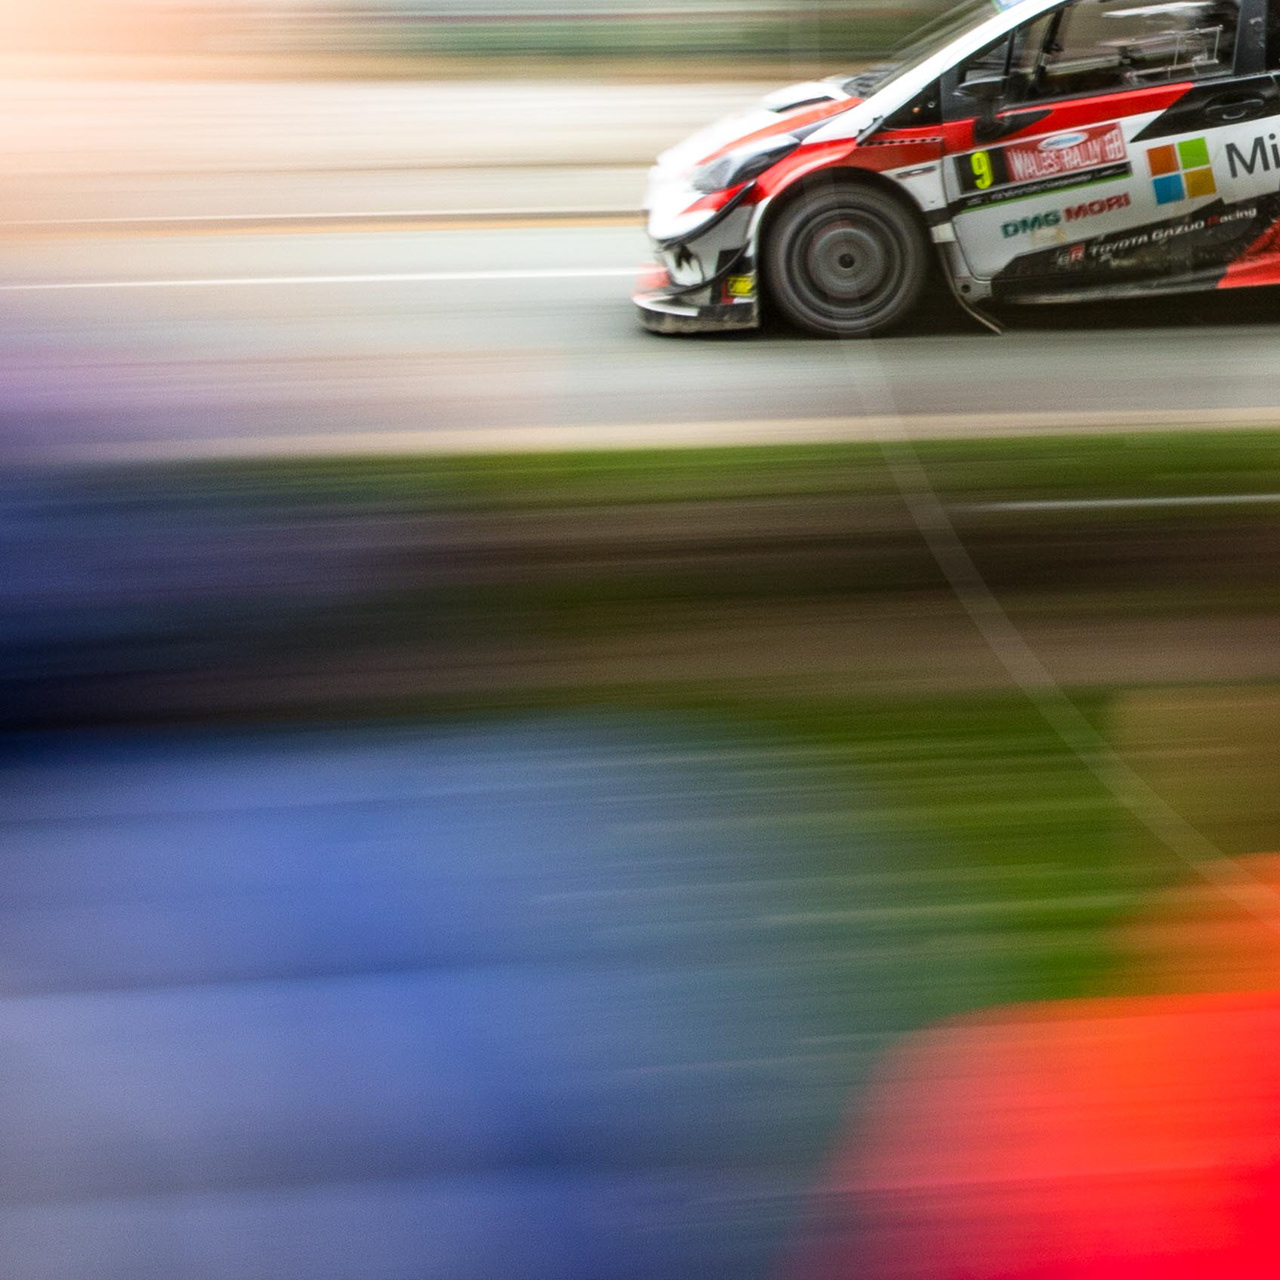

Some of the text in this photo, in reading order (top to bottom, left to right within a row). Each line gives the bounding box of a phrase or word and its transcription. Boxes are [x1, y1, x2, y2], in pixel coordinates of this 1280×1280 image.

[970, 150, 995, 190] 9
[1007, 148, 1062, 182] WALES
[1062, 138, 1100, 172] RALLY
[1103, 128, 1126, 161] GB
[1002, 192, 1131, 239] DMG MORI
[1089, 234, 1149, 258] TOYOTA
[1207, 207, 1258, 227] Racing
